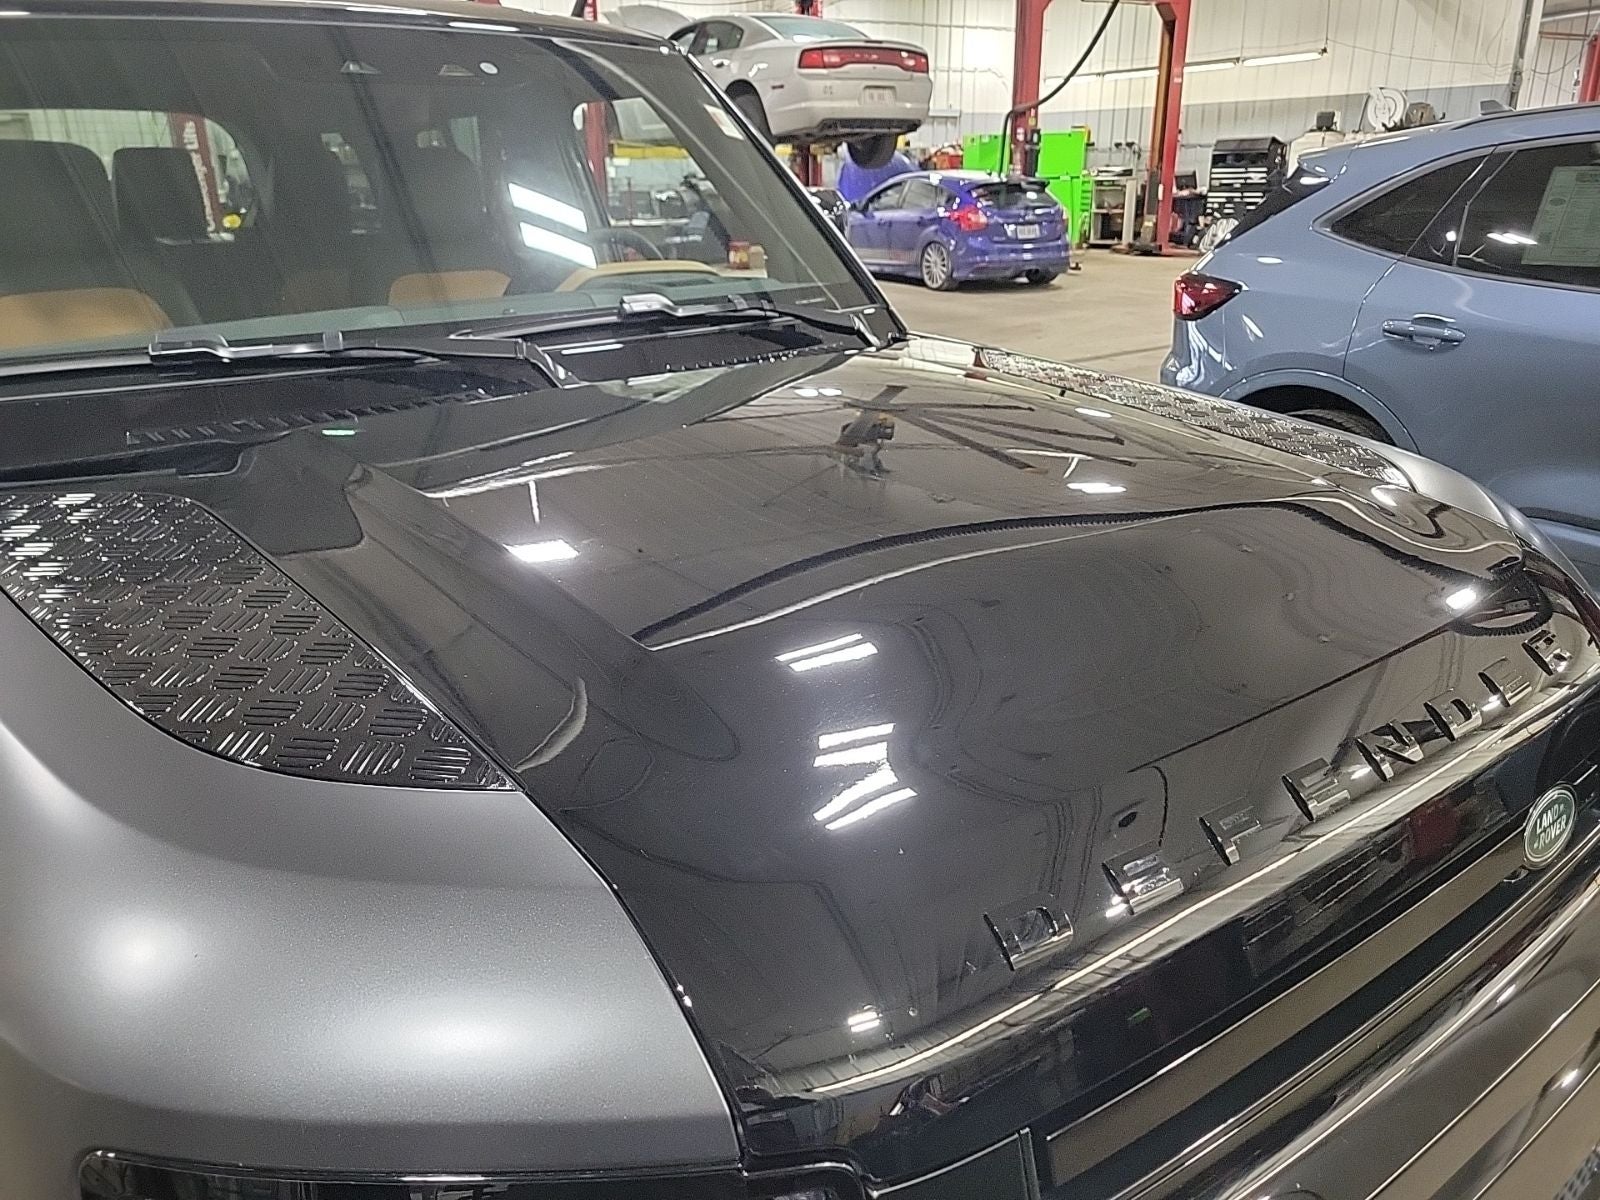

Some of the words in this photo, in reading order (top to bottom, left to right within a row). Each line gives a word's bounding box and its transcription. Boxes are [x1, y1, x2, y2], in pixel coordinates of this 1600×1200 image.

[983, 629, 1572, 971] DEFENDER
[1536, 804, 1559, 834] LAND
[1539, 815, 1567, 849] ROVER
